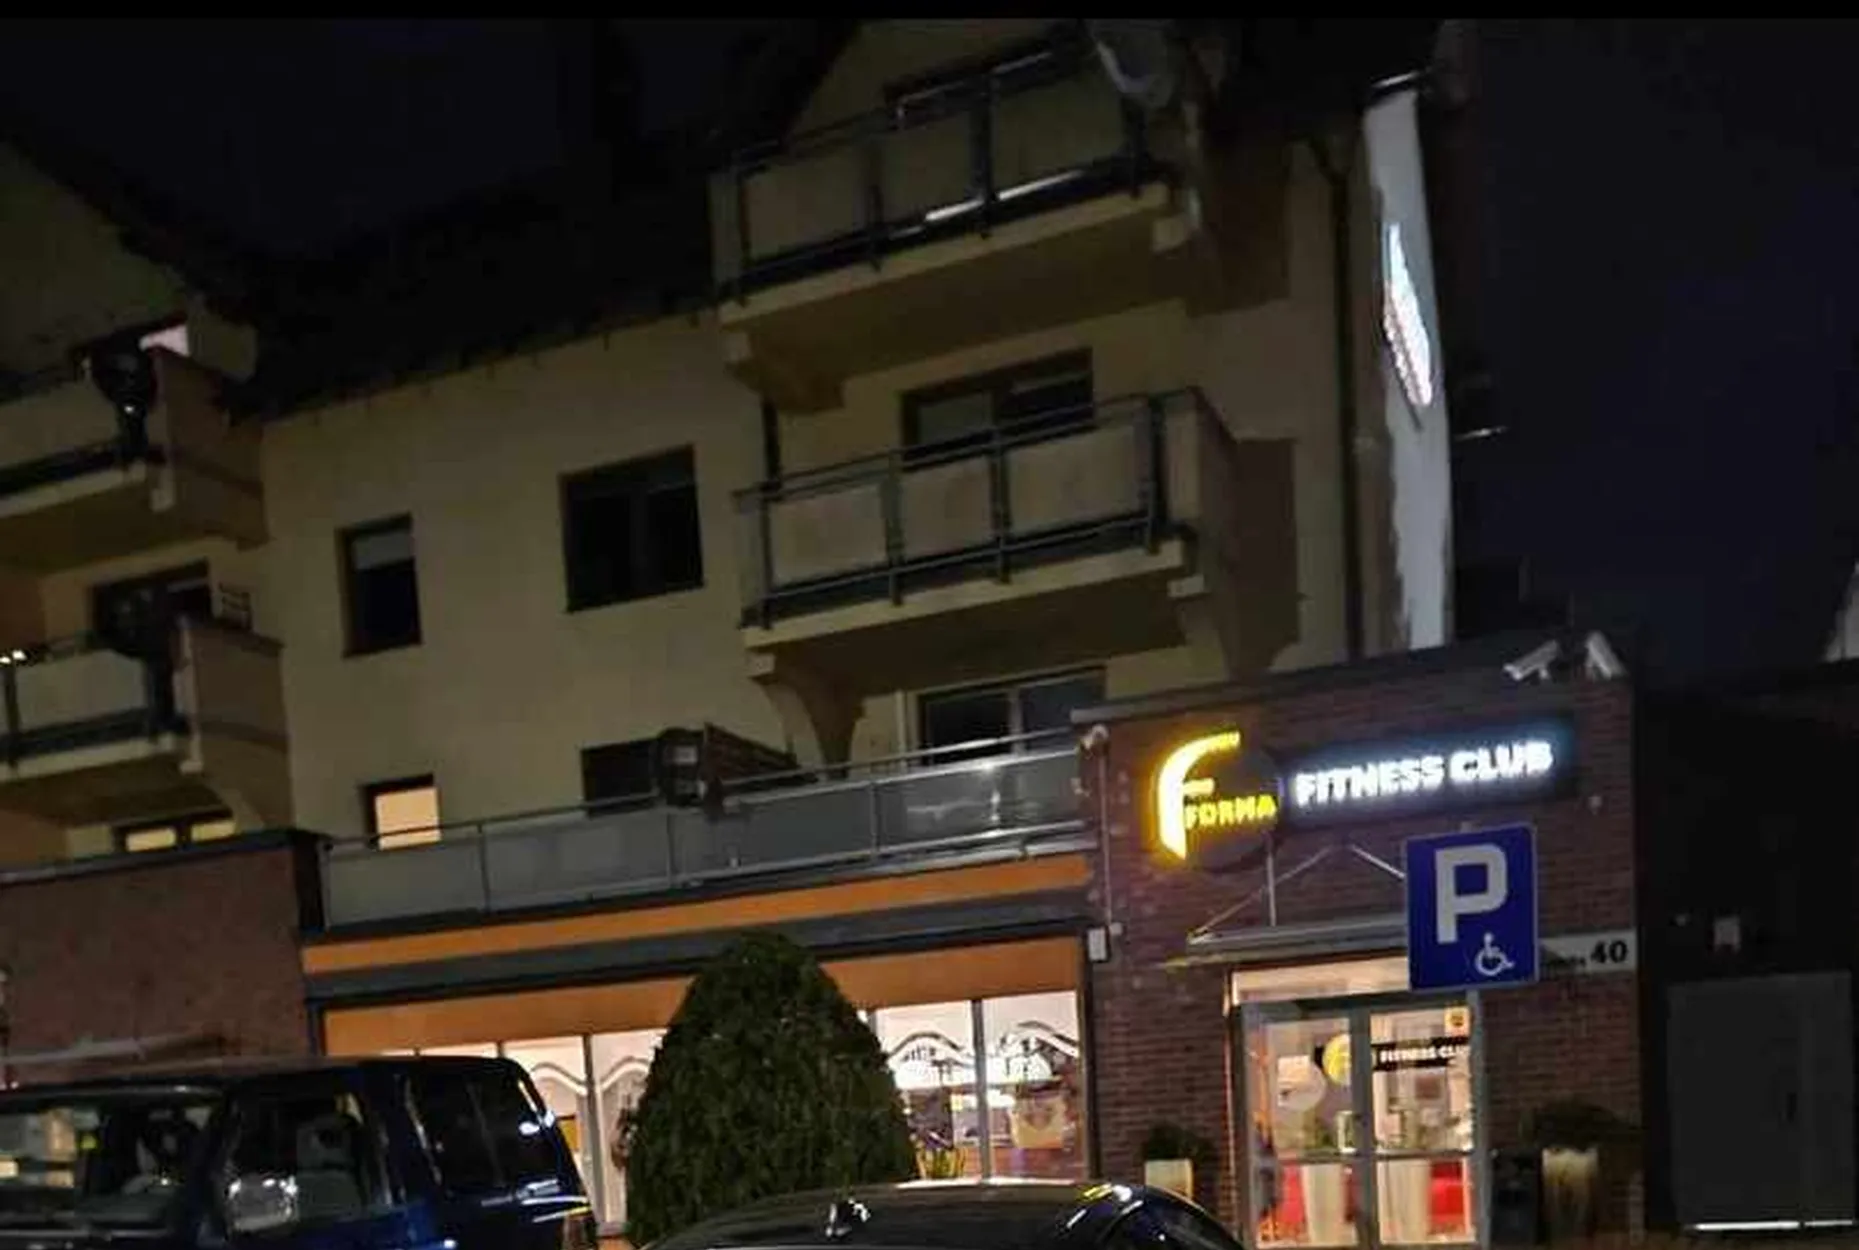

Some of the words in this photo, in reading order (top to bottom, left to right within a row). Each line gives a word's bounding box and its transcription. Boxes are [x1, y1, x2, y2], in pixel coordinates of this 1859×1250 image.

[1294, 755, 1445, 808] FITNESS
[1449, 740, 1553, 784] CLUB
[1184, 794, 1277, 830] FORMA
[1436, 844, 1508, 945] P
[1590, 940, 1628, 964] 40
